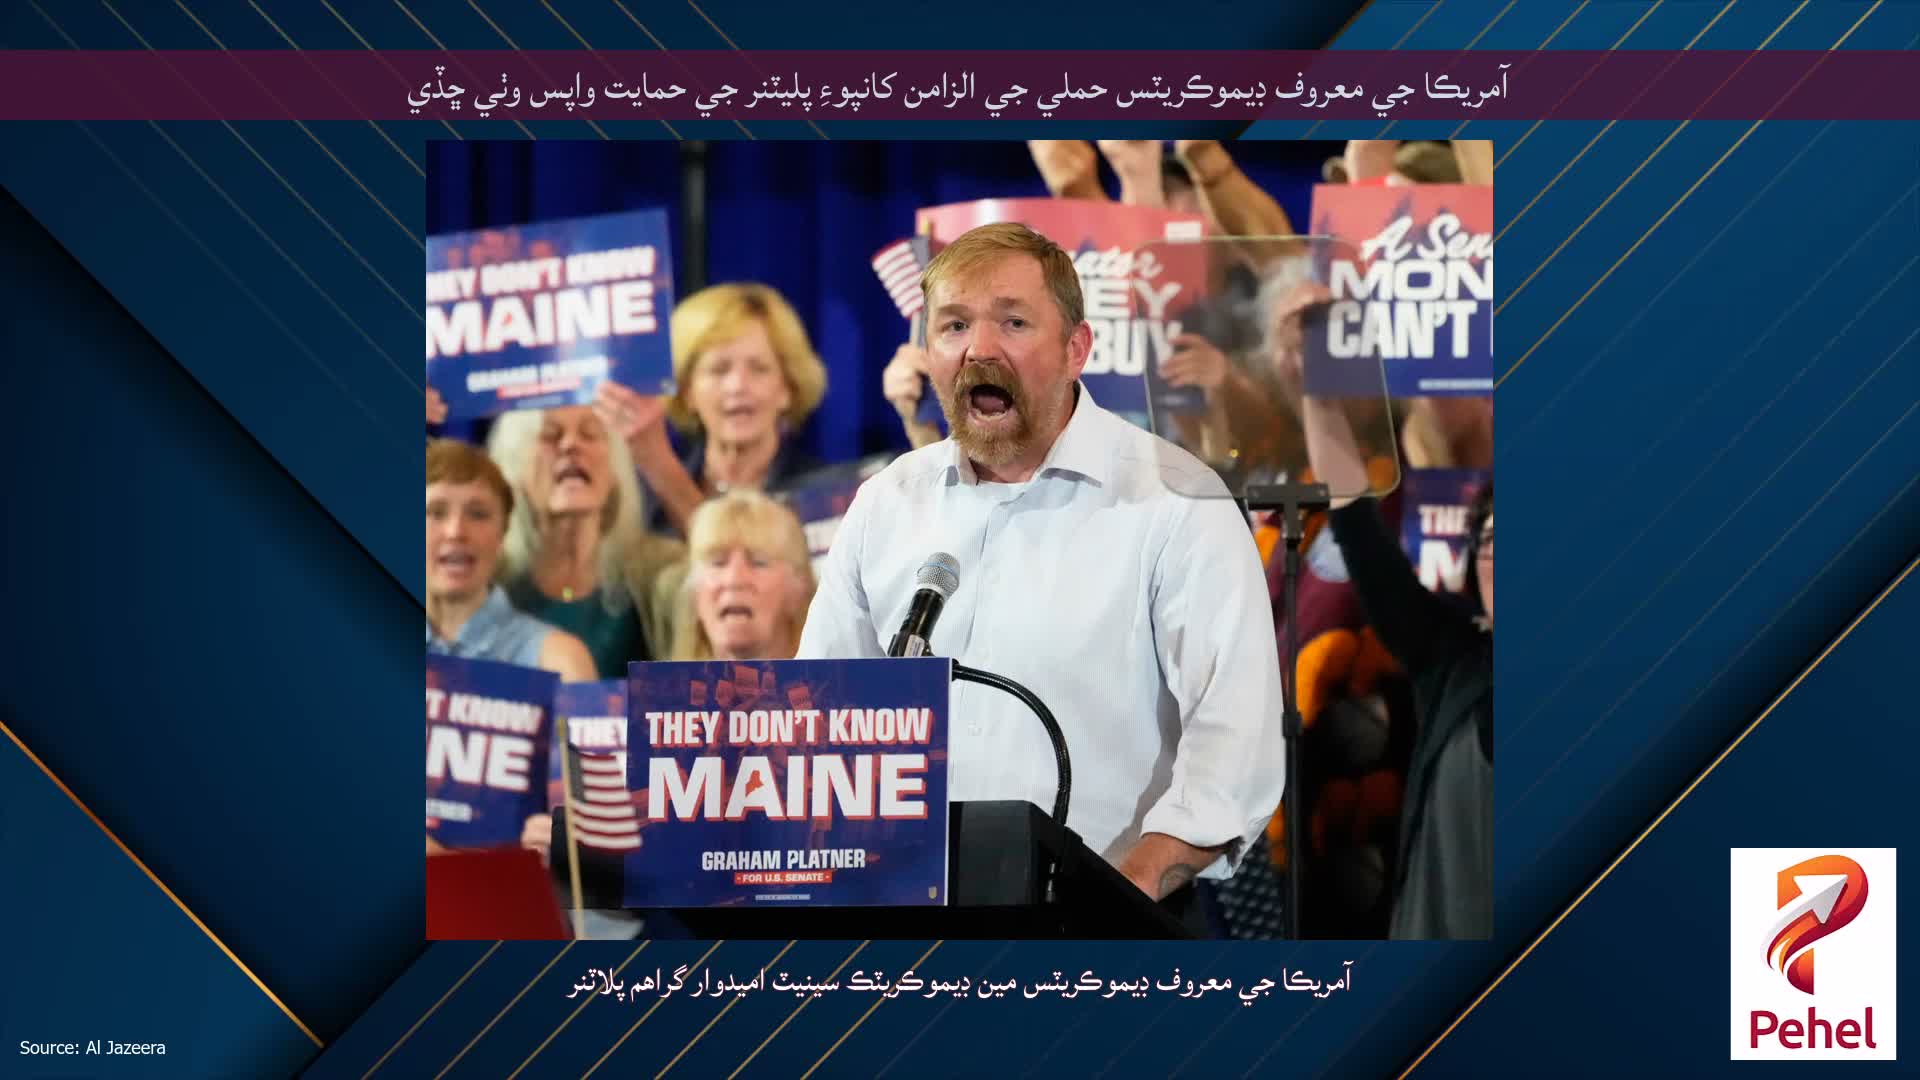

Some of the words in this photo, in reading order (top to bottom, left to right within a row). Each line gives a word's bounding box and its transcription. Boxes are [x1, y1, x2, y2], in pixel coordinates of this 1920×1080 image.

[1360, 215, 1414, 261] A
[1330, 259, 1493, 300] MON
[426, 279, 657, 358] MAINE
[1327, 301, 1478, 359] CAN'T
[645, 711, 721, 745] THEY
[728, 709, 820, 743] DON'T
[828, 708, 931, 742] KNOW
[648, 754, 927, 820] MAINE
[702, 850, 781, 871] GRAHAM
[787, 849, 866, 869] PLATNER
[742, 873, 762, 883] FOR
[765, 873, 783, 883] U.S.
[785, 872, 823, 882] SENATE
